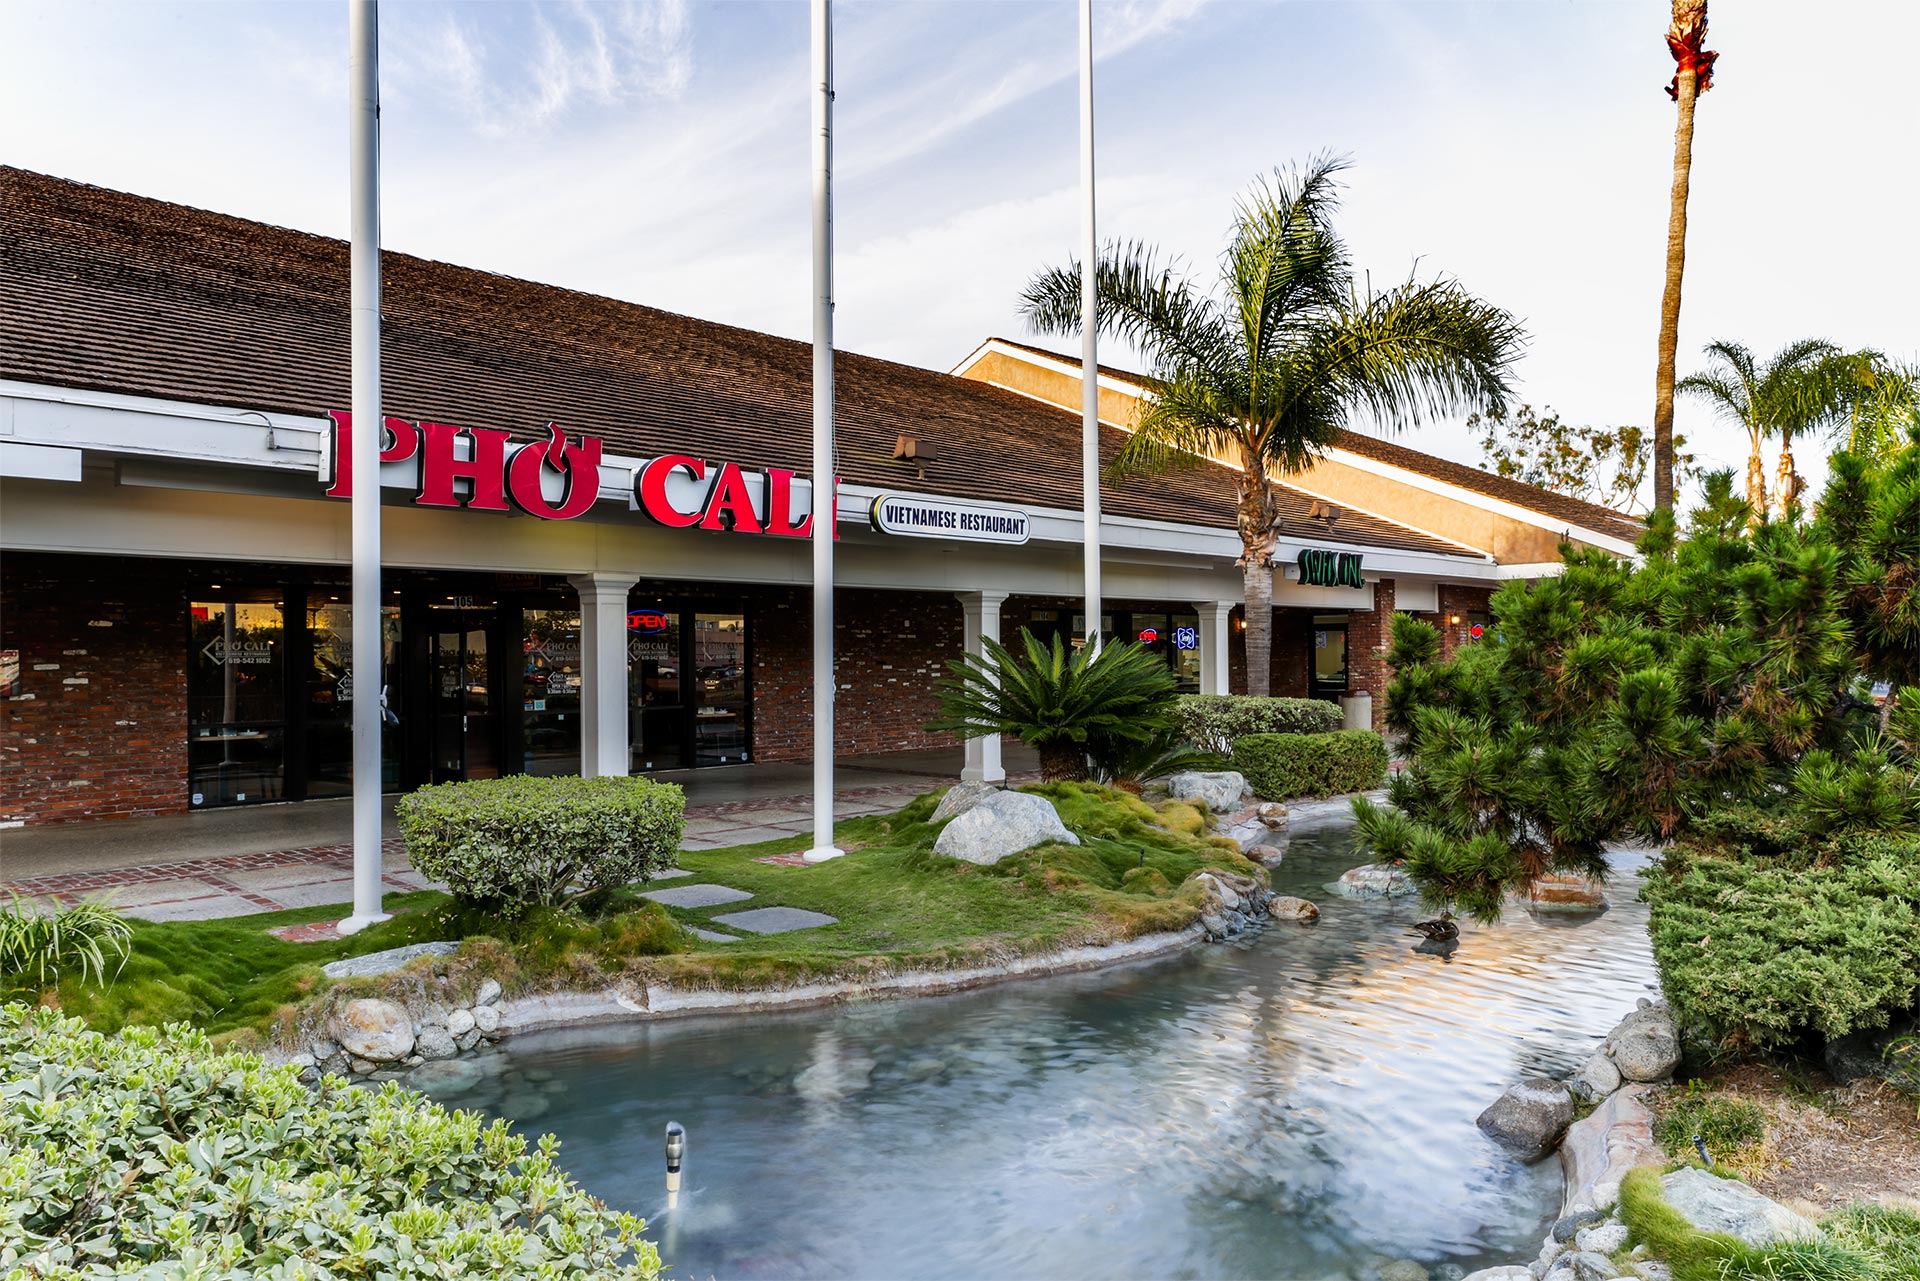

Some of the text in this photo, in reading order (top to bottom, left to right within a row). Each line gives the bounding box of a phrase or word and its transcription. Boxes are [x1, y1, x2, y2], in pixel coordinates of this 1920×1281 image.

[886, 505, 1025, 535] VIETNAMESE RESTAURANT
[626, 615, 666, 628] OPEN
[244, 641, 271, 650] CALI
[651, 642, 668, 650] CALI
